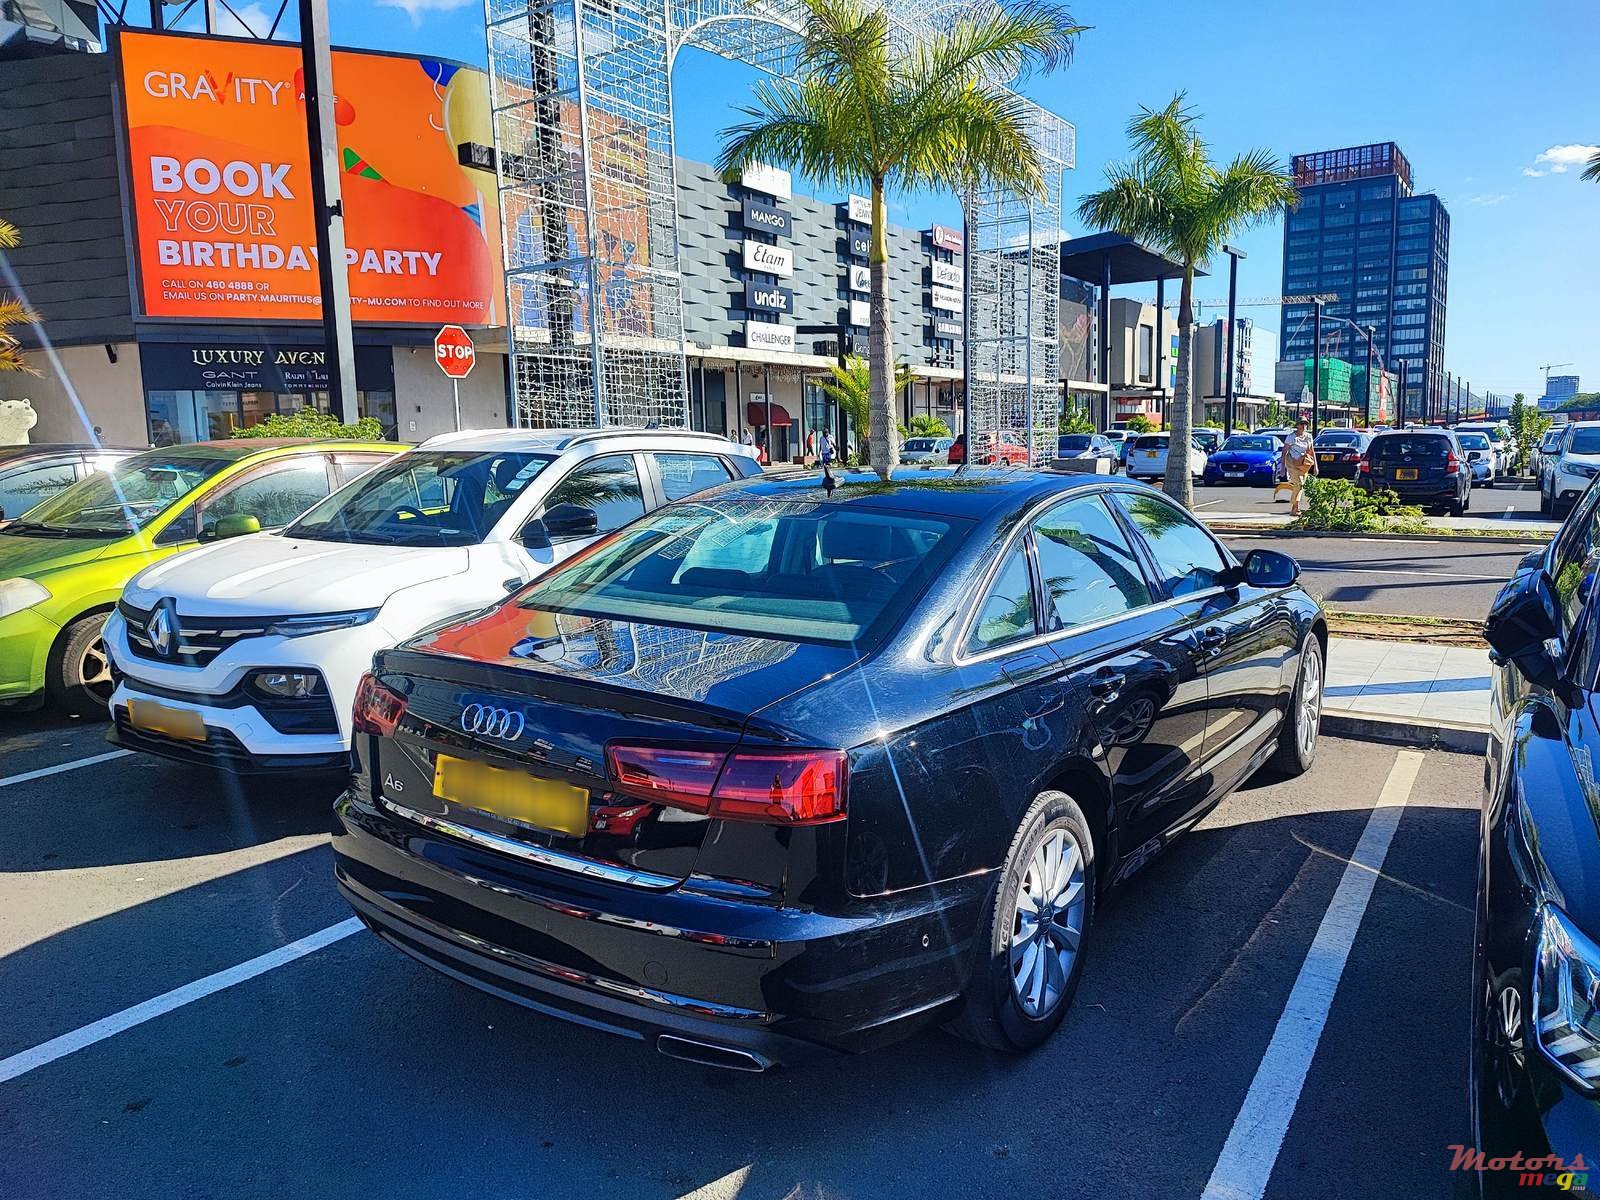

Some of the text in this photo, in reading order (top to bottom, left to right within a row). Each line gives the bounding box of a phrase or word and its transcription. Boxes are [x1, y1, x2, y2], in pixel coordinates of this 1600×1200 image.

[143, 69, 283, 106] GRAVITY
[150, 156, 296, 200] BOOK
[154, 199, 277, 237] YOUR
[751, 209, 785, 228] MANGO
[343, 248, 442, 276] PARTY
[753, 245, 785, 267] Etam
[162, 279, 270, 291] CALL ON 460 4888 OR
[163, 291, 192, 300] EMAIL
[194, 292, 207, 301] US
[209, 292, 225, 301] ON
[408, 298, 420, 307] TO
[422, 299, 442, 308] FIND
[443, 300, 460, 309] OUT
[462, 301, 484, 310] MORE
[754, 290, 787, 309] undiz
[751, 331, 792, 345] CHALLENGER
[192, 349, 326, 366] LUXURY AVEN
[437, 343, 472, 360] STOP
[202, 371, 258, 379] GANT
[384, 773, 404, 792] A6
